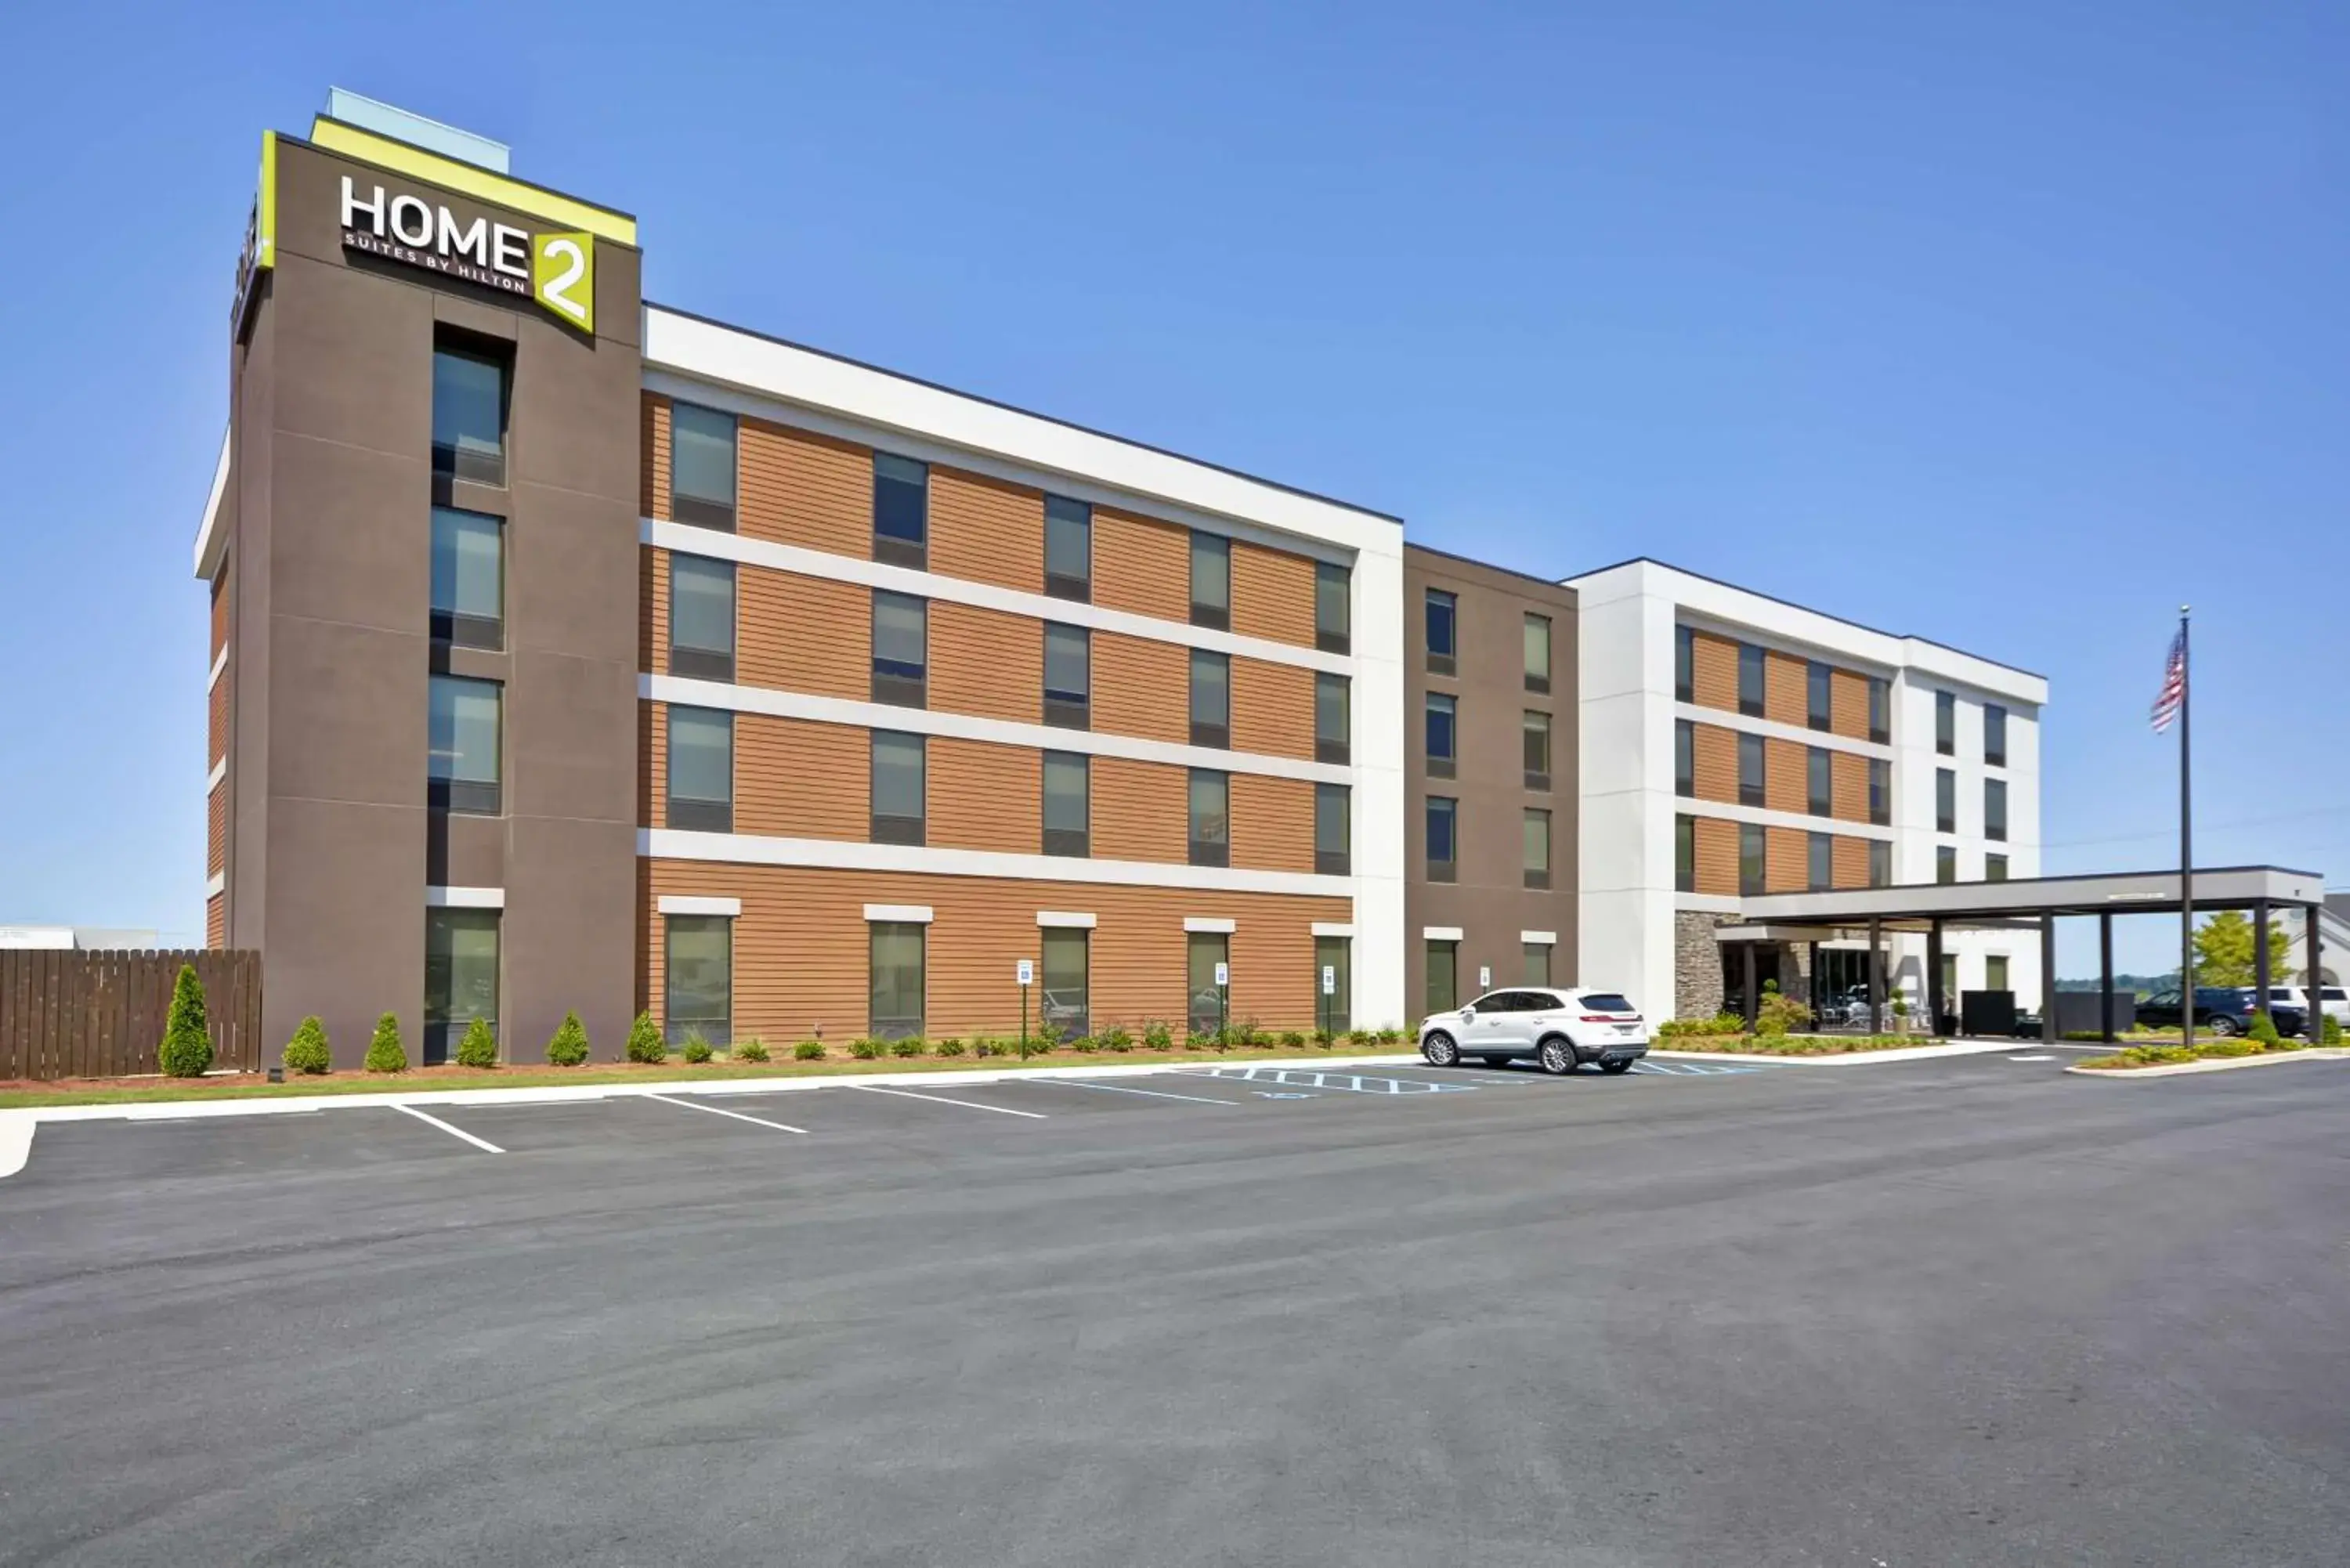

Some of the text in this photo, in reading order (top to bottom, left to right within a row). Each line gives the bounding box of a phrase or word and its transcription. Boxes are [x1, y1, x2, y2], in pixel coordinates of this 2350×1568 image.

[342, 175, 529, 279] HOME
[543, 239, 586, 320] 2
[345, 233, 525, 294] SUITES BY HILTON
